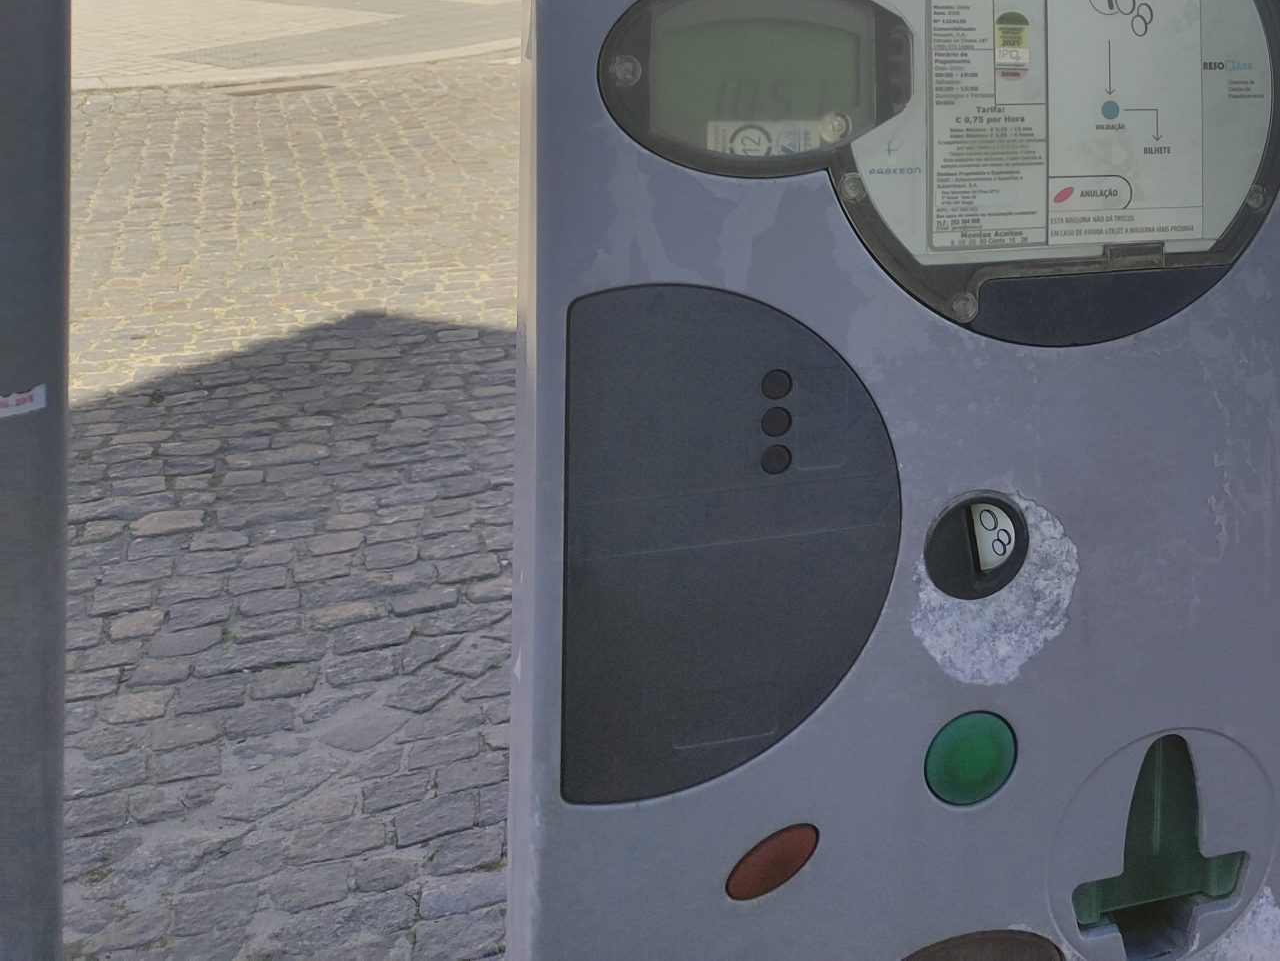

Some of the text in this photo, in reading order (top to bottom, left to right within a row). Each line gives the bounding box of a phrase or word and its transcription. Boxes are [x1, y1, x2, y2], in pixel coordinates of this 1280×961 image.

[964, 116, 984, 125] 0,75
[986, 116, 1002, 124] por
[1144, 146, 1171, 154] BILHETE
[869, 167, 921, 175] PARKEON
[1080, 188, 1118, 199] ANULAÇÃO
[1050, 229, 1060, 237] EM
[1060, 229, 1075, 237] CASO
